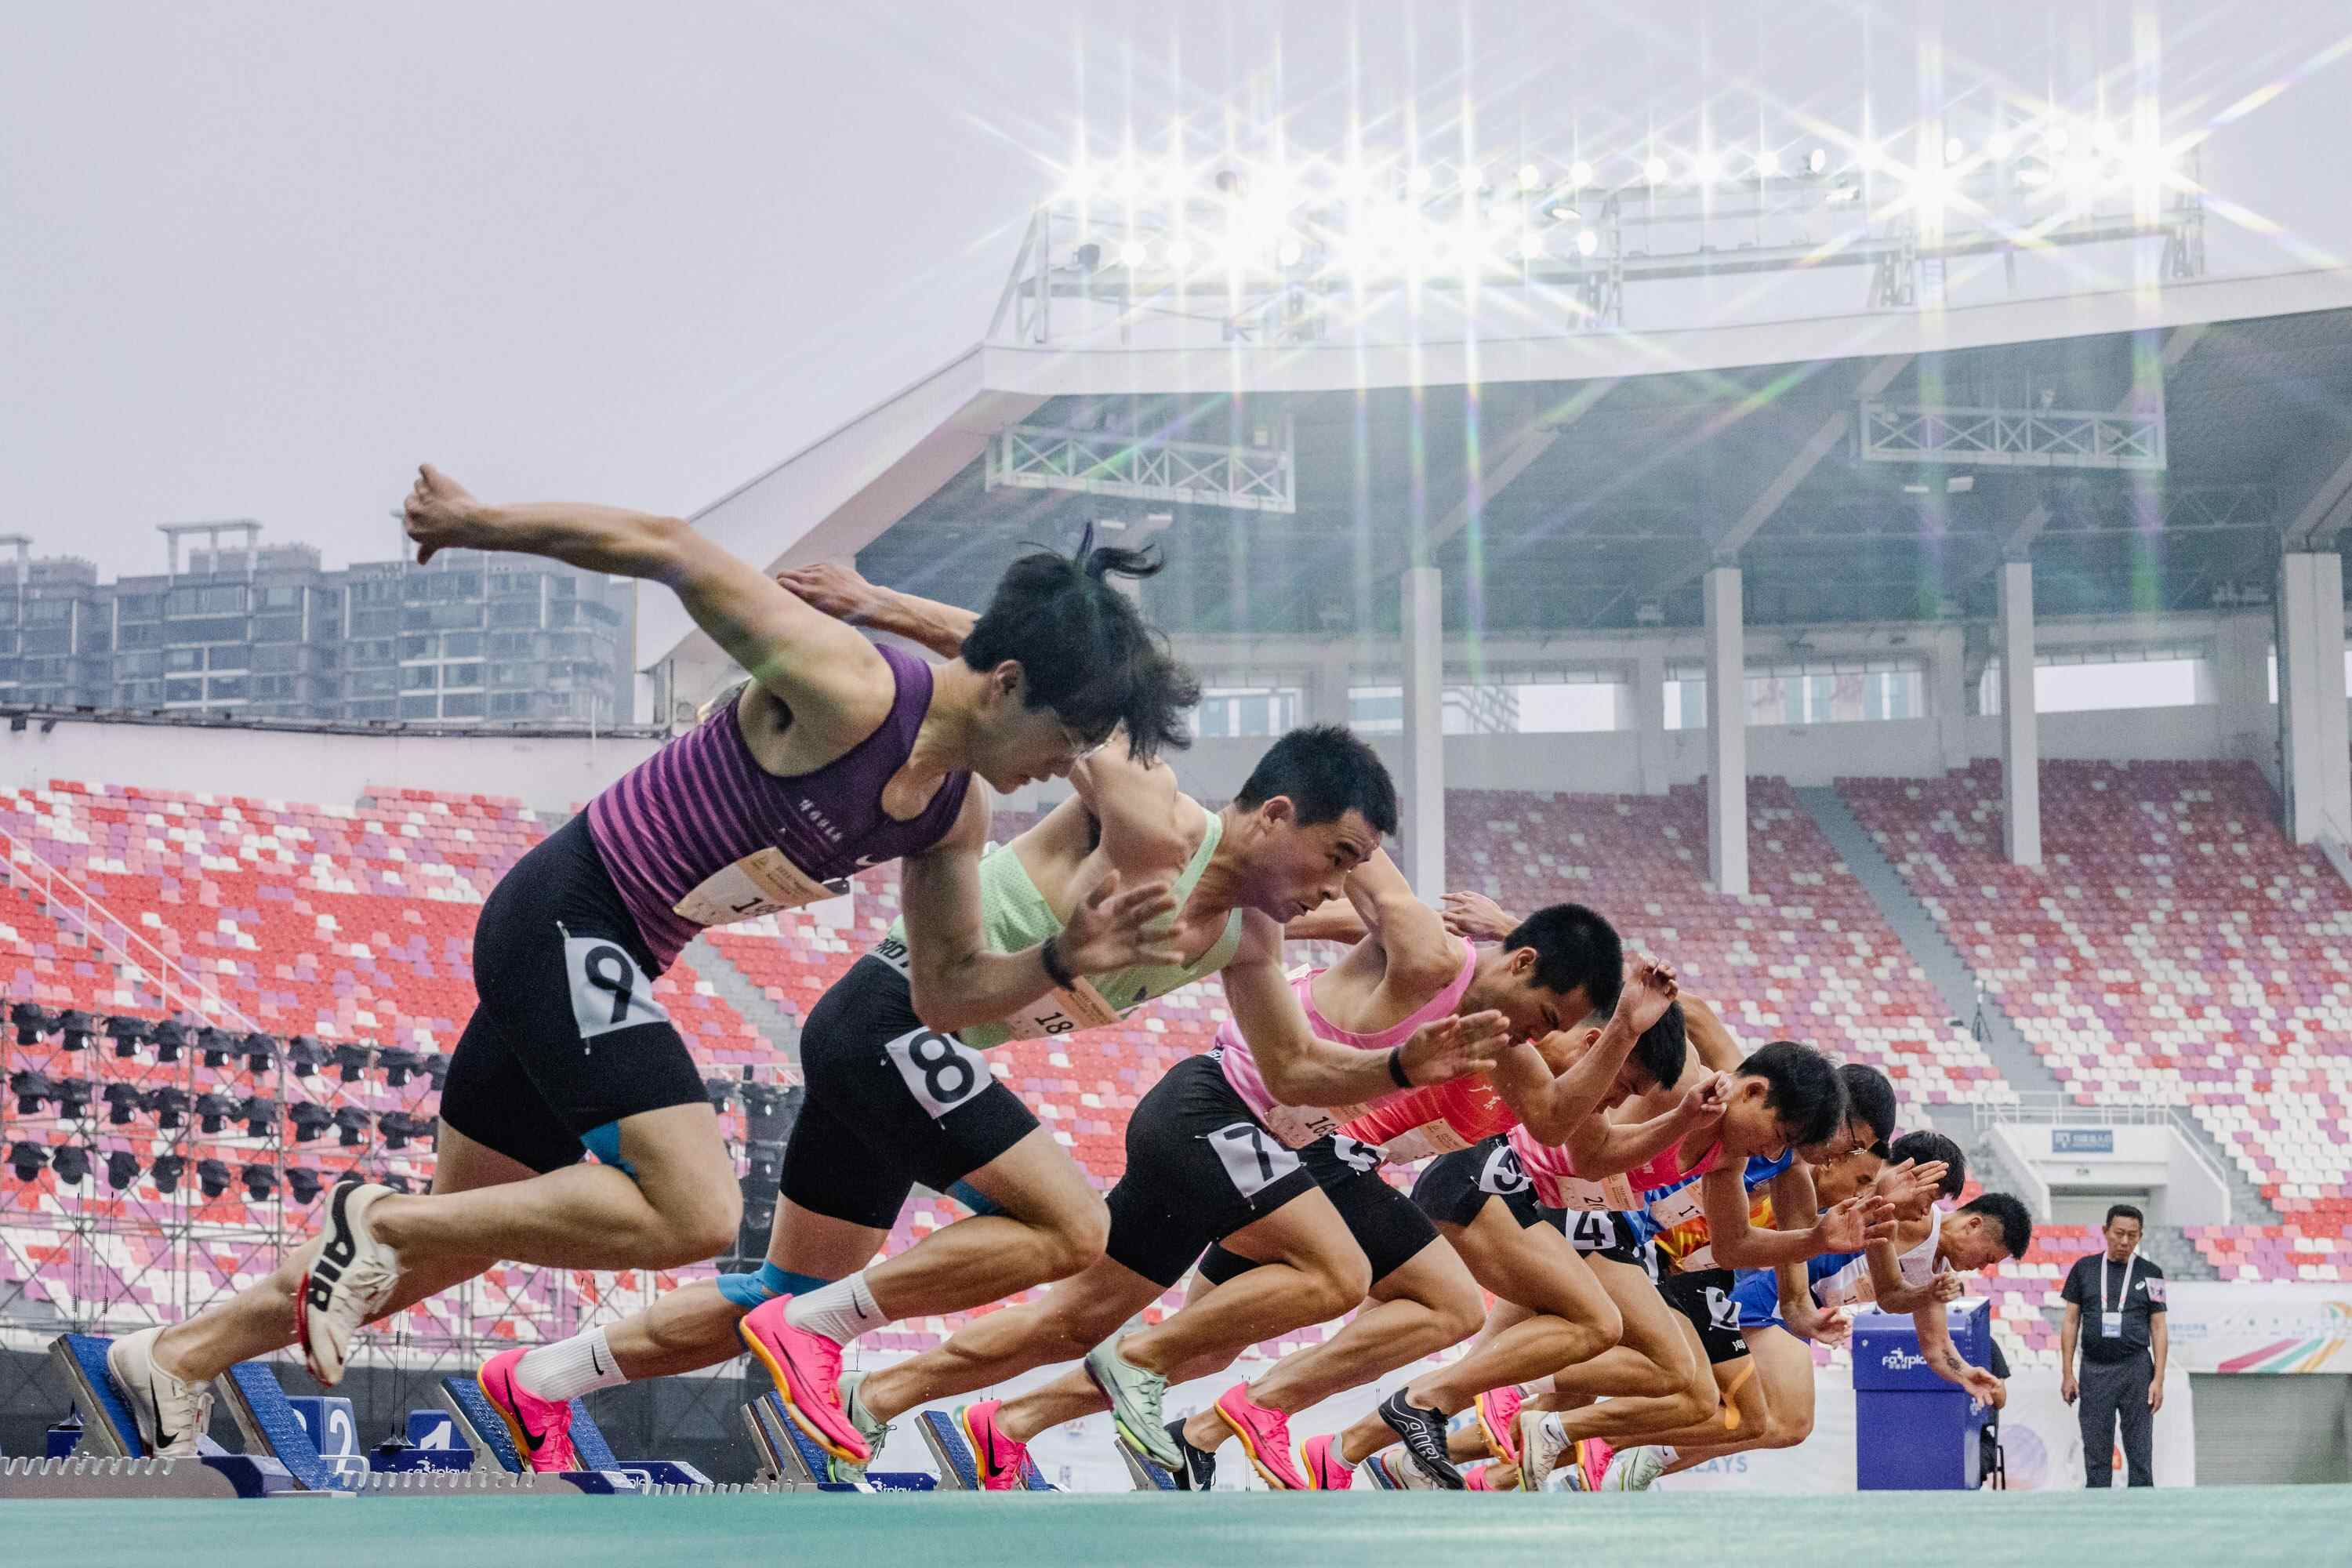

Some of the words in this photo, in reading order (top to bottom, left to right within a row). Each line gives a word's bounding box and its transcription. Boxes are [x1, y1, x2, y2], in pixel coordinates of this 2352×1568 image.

[585, 946, 633, 1024] 9
[909, 1031, 975, 1103] 8
[1223, 1126, 1274, 1182] 7
[1573, 1211, 1606, 1246] 4
[329, 1409, 352, 1475] 2
